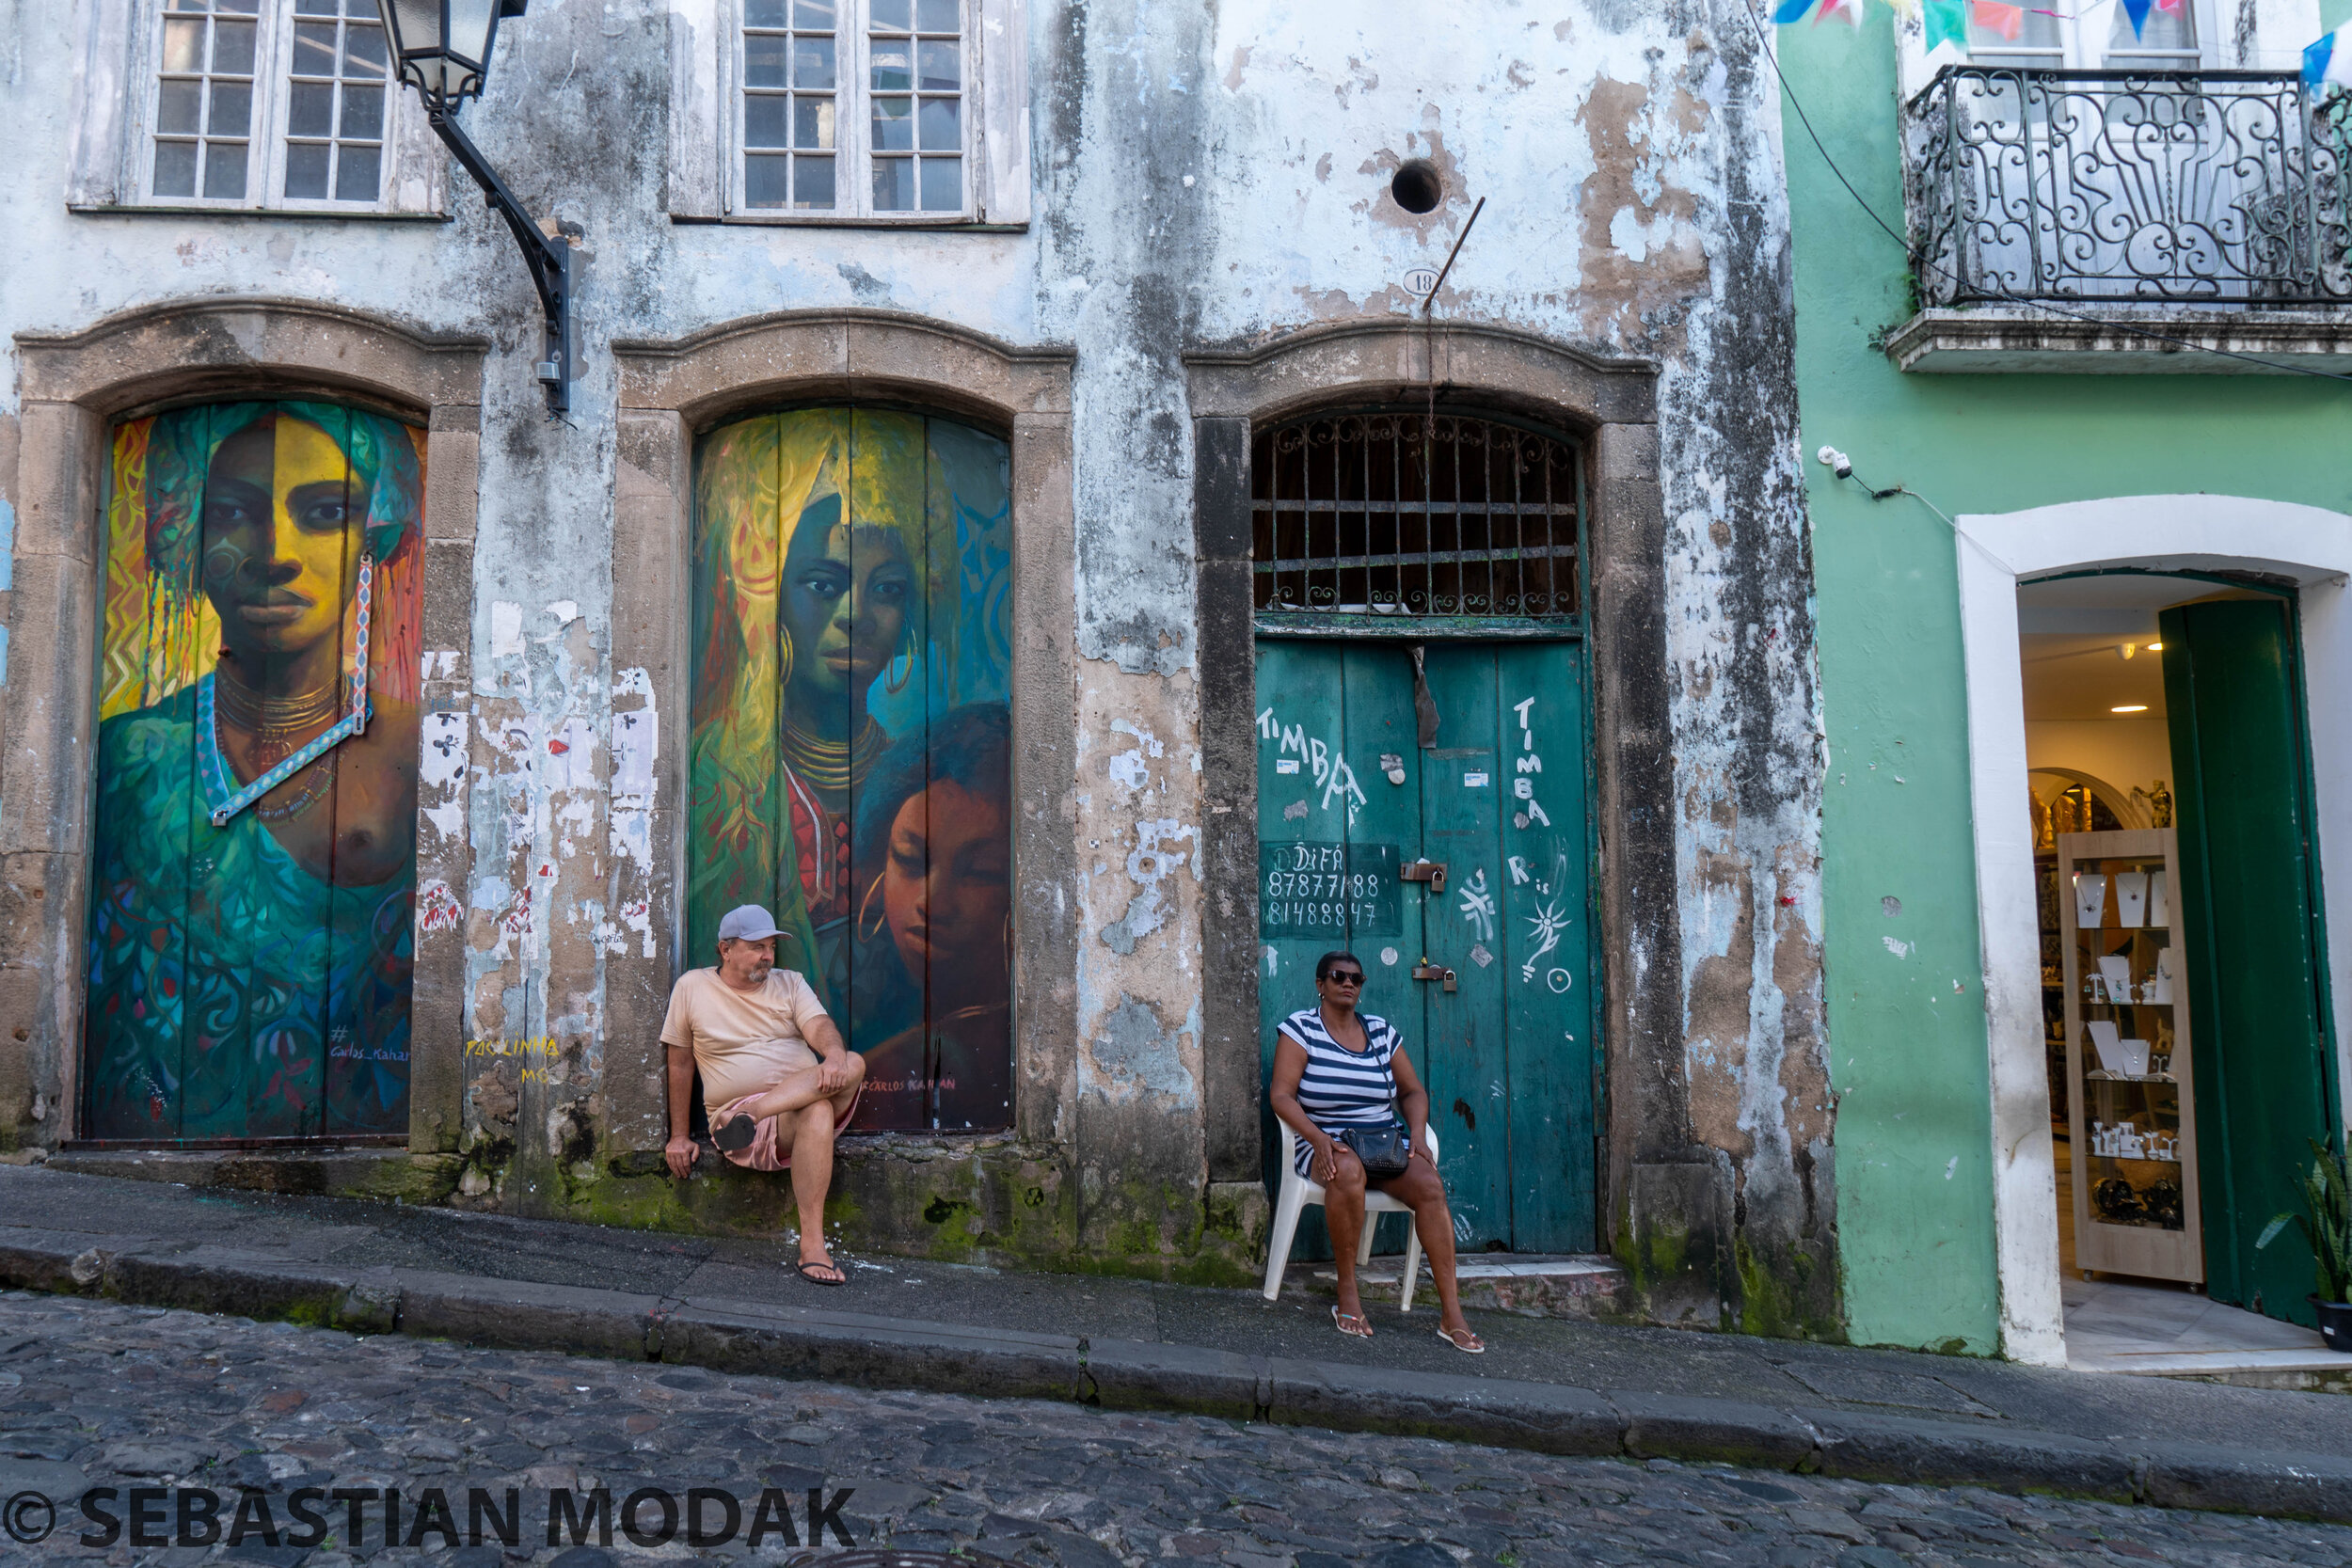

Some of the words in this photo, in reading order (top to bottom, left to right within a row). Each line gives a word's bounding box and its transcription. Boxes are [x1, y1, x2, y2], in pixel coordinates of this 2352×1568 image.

[1416, 274, 1432, 291] 18
[1256, 706, 1367, 810] TIMBA
[1513, 696, 1550, 827] TIMBA
[1269, 871, 1379, 898] 87877188
[1269, 901, 1375, 927] 81488847
